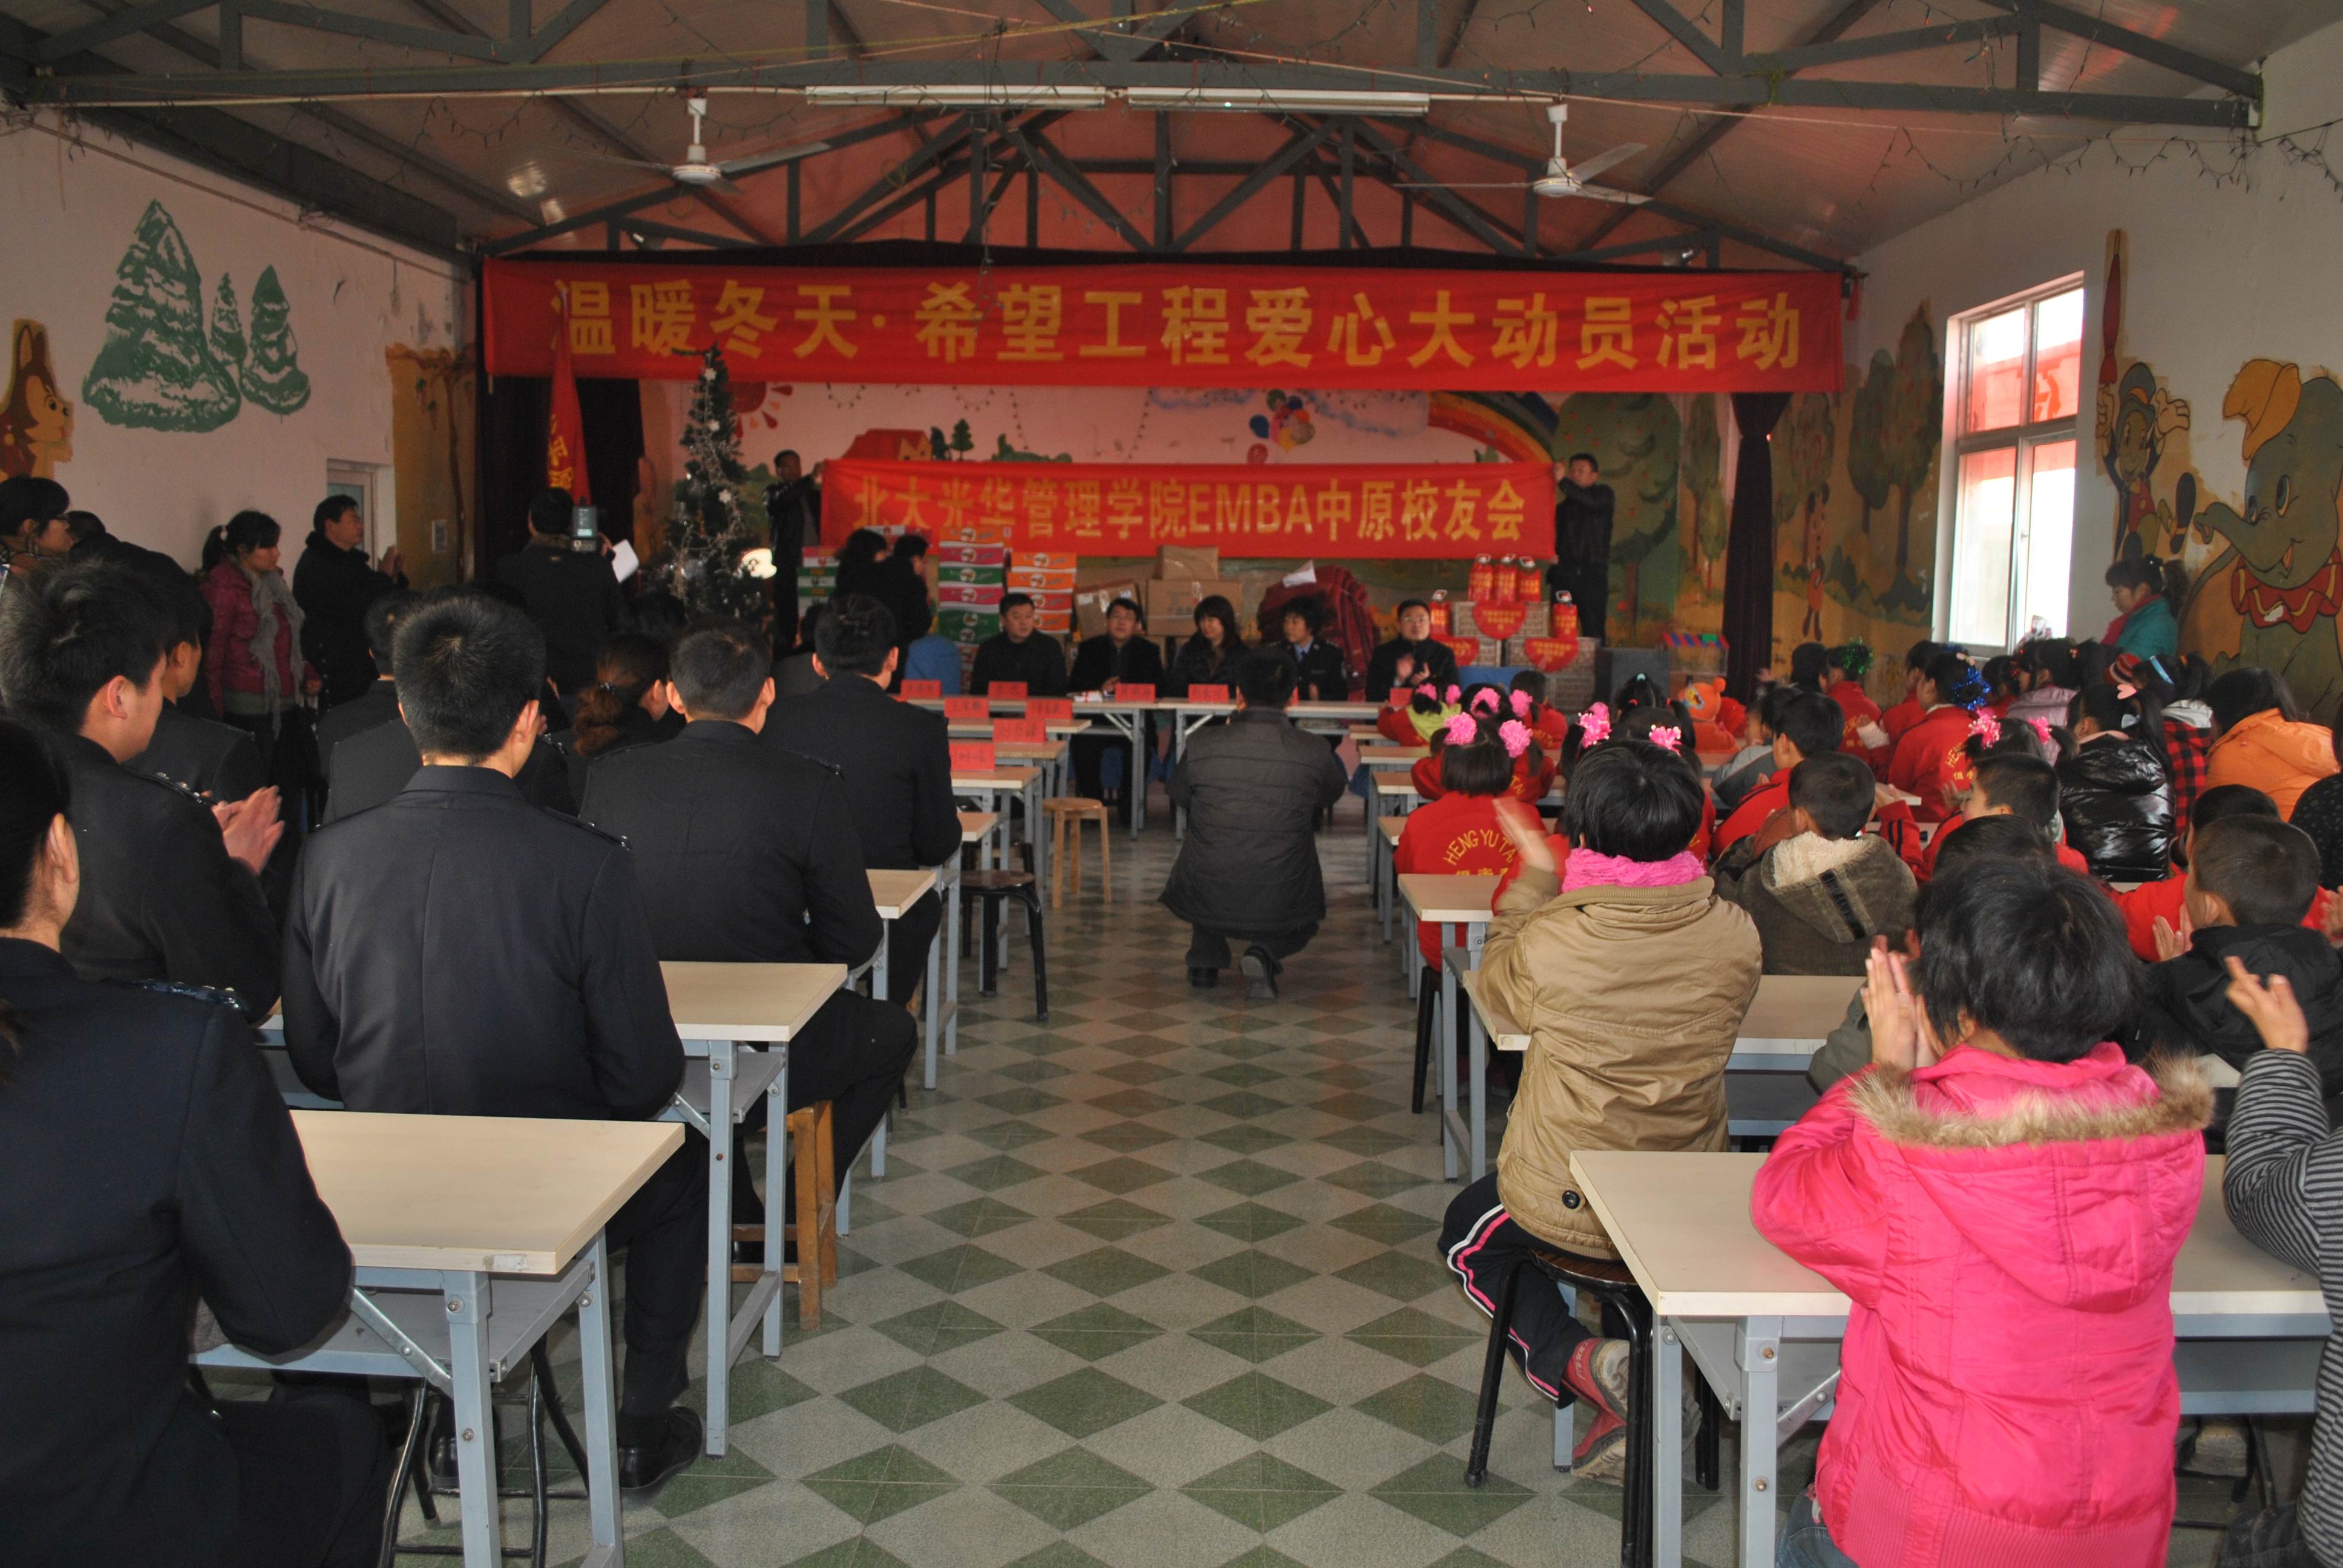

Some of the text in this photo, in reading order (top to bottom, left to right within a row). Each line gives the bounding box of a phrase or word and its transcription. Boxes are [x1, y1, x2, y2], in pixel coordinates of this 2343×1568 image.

[551, 279, 1800, 370] 温暖冬天·希望工程爱心大动员活动
[852, 474, 1525, 543] 北大光华管理学院EMBA中原校友会
[1443, 829, 1479, 865] HENG
[1480, 828, 1499, 848] YU
